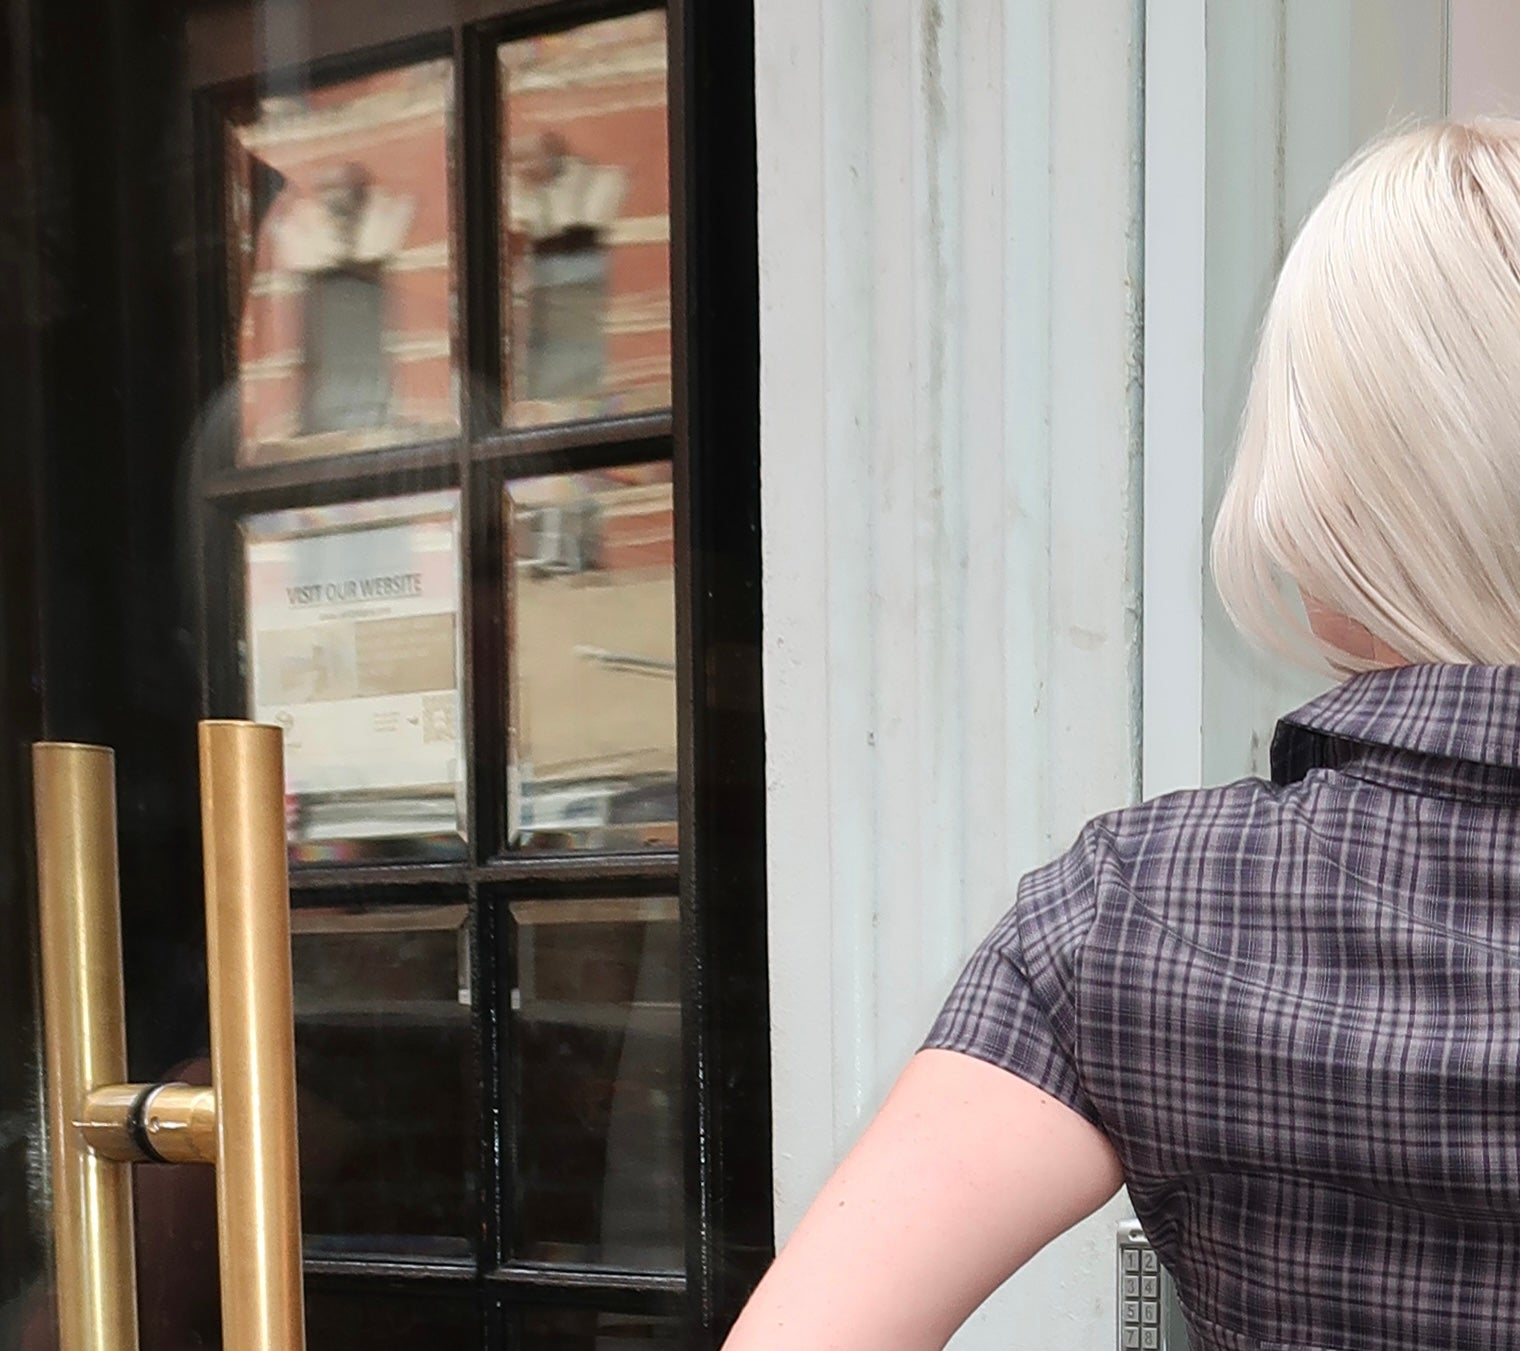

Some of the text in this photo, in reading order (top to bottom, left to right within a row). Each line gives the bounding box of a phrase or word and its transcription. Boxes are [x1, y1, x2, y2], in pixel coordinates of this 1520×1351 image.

[286, 572, 423, 605] VISIT OUR WEBSITE
[1144, 1253, 1153, 1269] 2
[1127, 1279, 1135, 1294] 3
[1126, 1304, 1153, 1320] 5 6
[1126, 1330, 1153, 1346] 7 8
